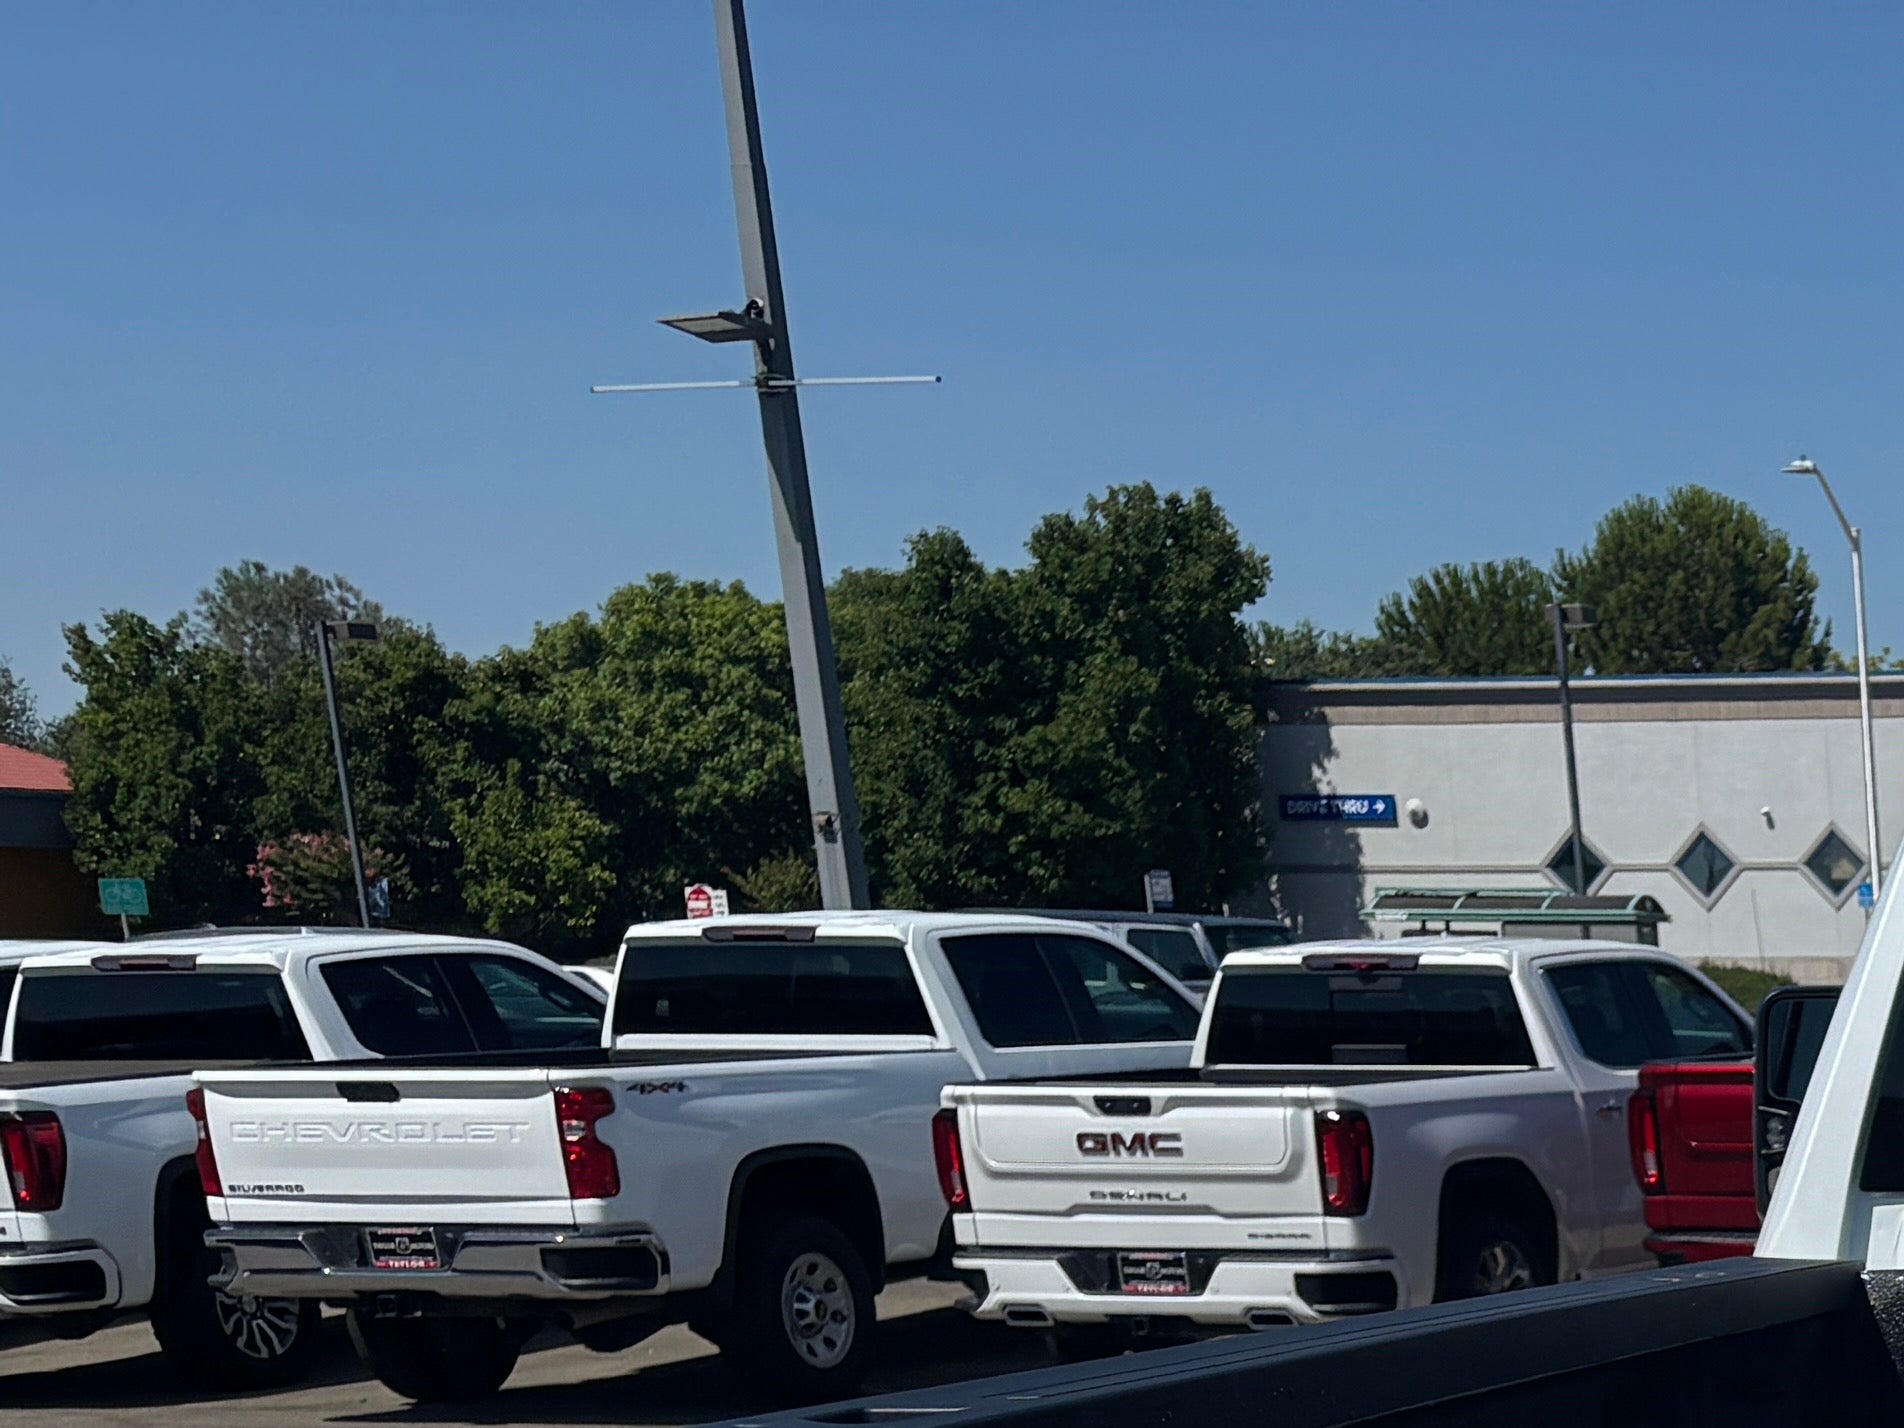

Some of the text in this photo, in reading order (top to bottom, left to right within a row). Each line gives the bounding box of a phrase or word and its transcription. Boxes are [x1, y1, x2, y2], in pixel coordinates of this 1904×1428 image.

[1286, 798, 1369, 815] DRIVE THRU
[229, 1121, 530, 1143] CHEVROLET
[1076, 1132, 1184, 1158] GMC
